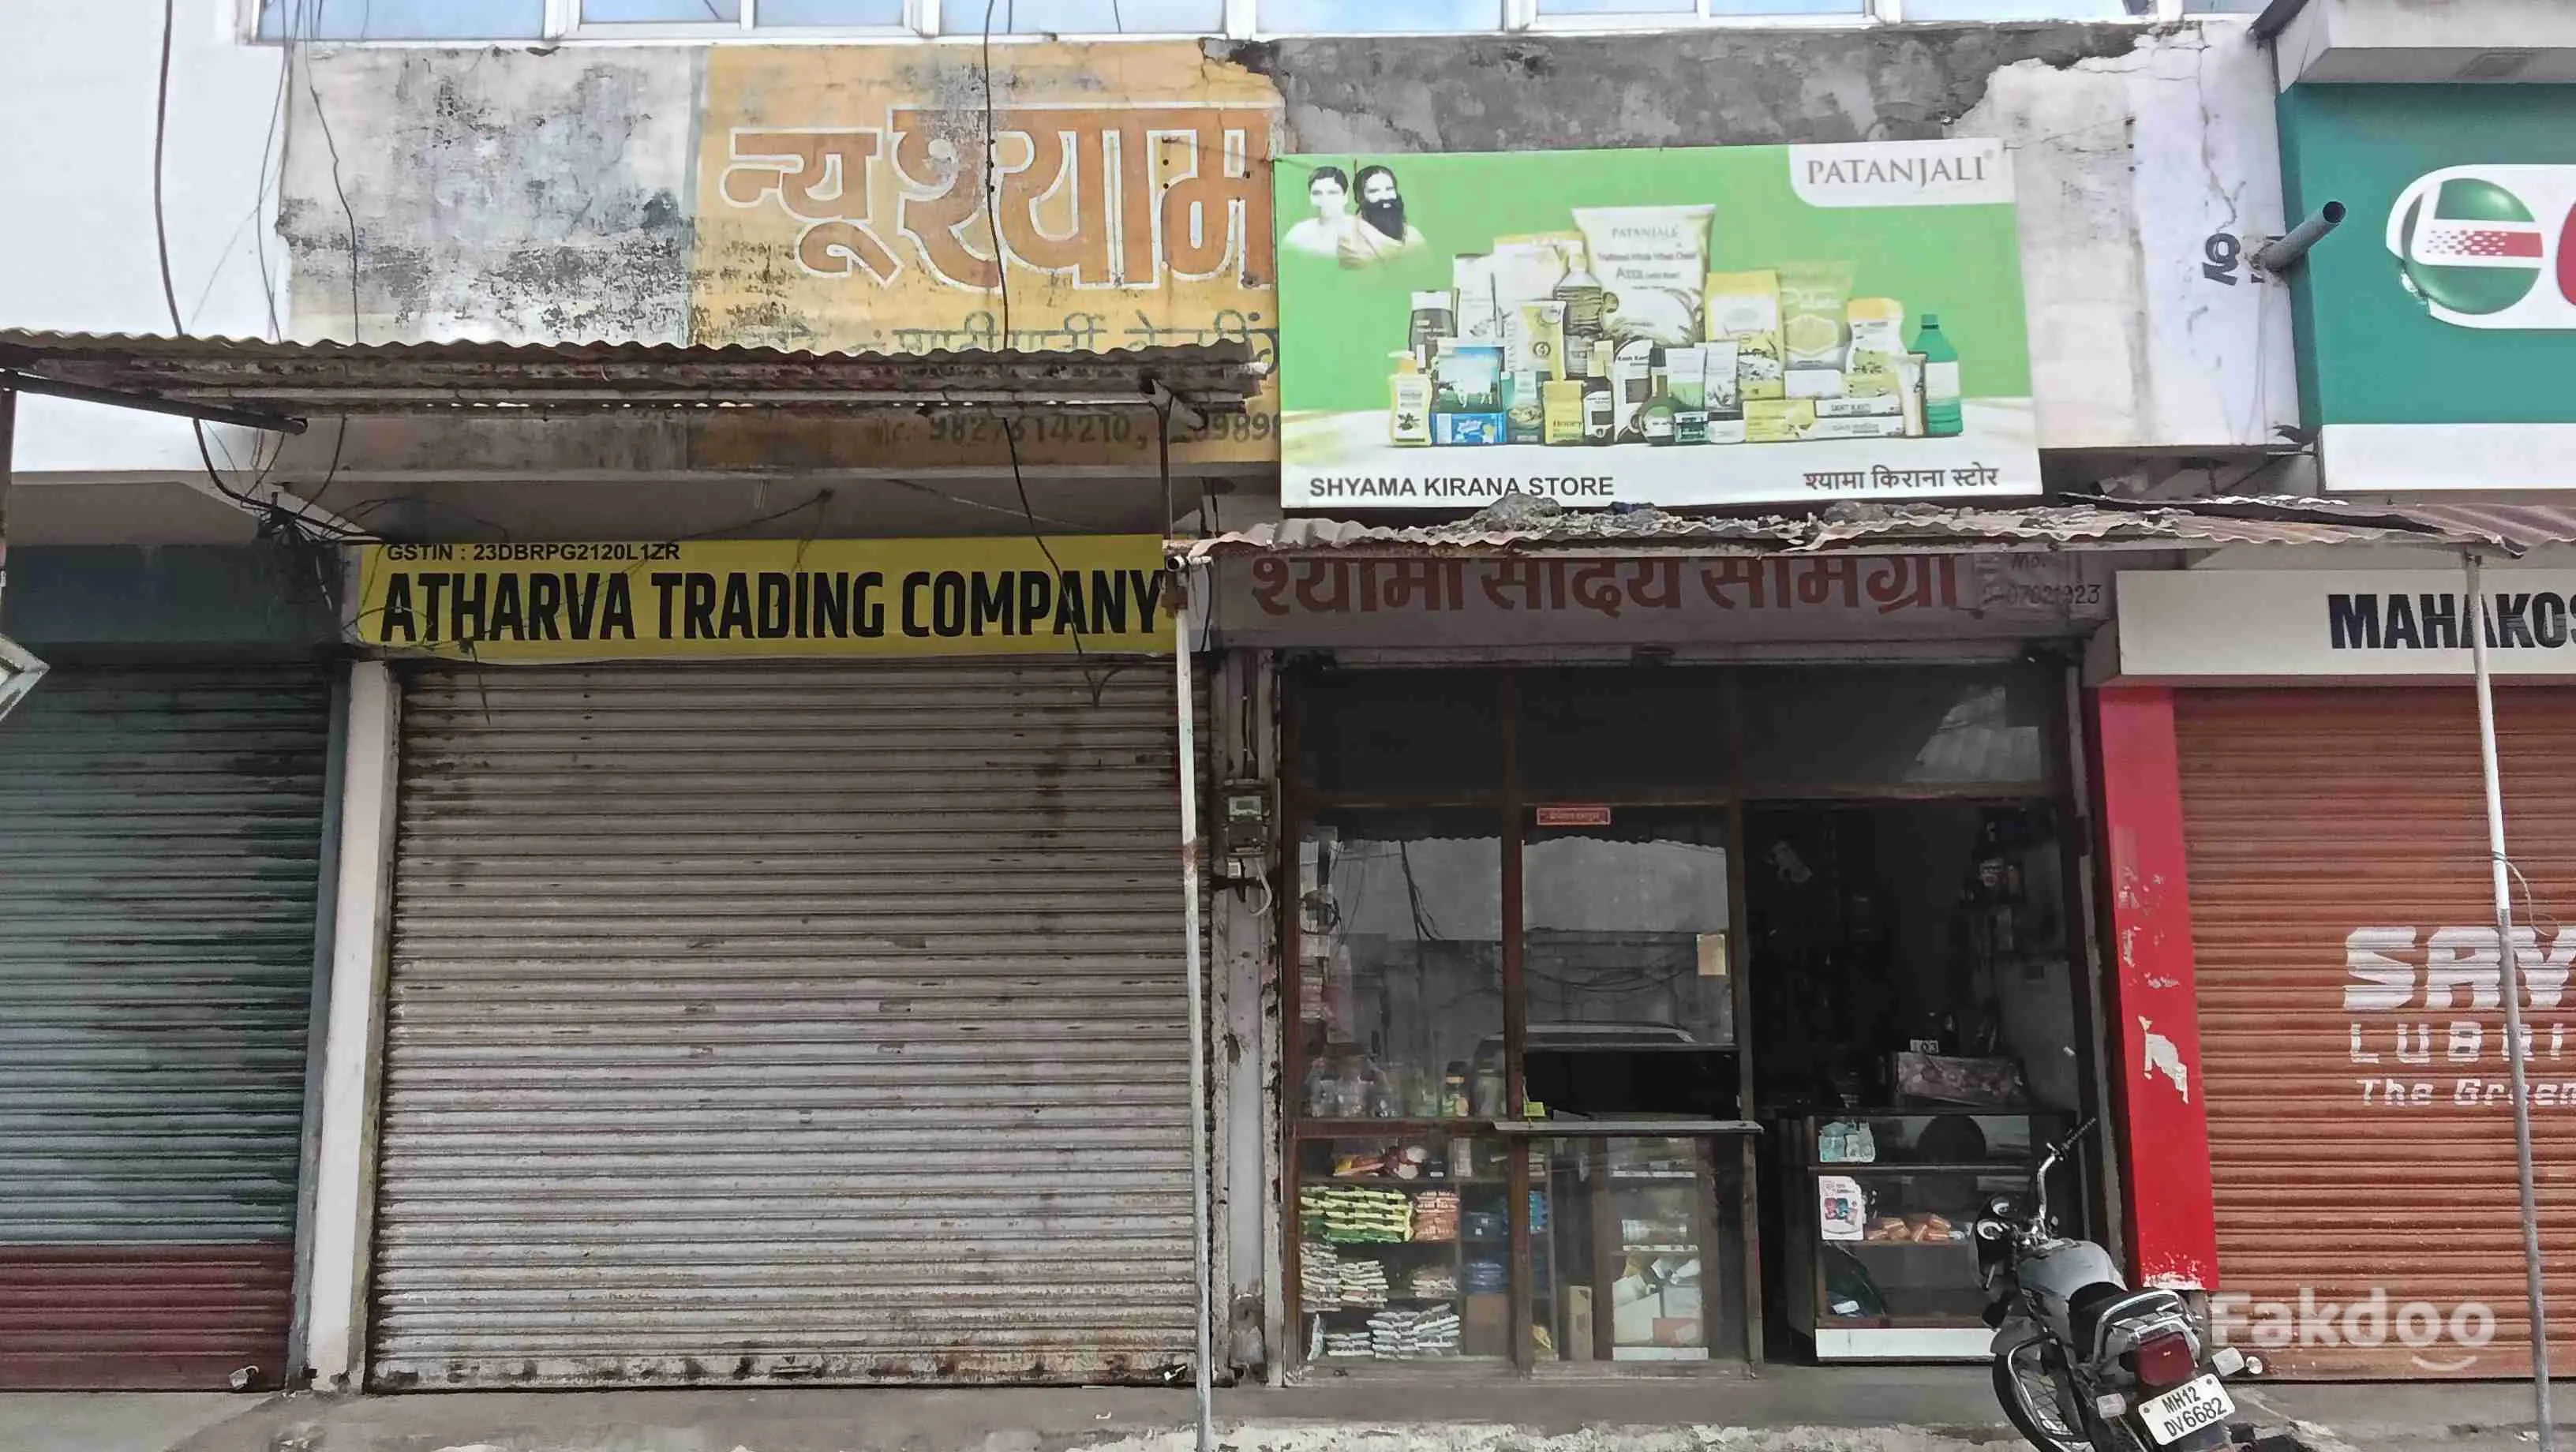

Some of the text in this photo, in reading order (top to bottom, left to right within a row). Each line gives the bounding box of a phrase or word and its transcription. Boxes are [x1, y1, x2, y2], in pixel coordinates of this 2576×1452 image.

[1807, 155, 1986, 187] PATANJALI
[1310, 476, 1614, 497] SHYAMA KIRANA STORE
[1803, 462, 2000, 490] श्यामा किराना स्टोर
[387, 544, 452, 561] GSTIN
[380, 569, 1165, 642] ATHARVA TRADING COMPANY
[2328, 593, 2576, 650] MAHAKO
[2357, 1079, 2433, 1106] The
[2162, 1386, 2201, 1413] MH12
